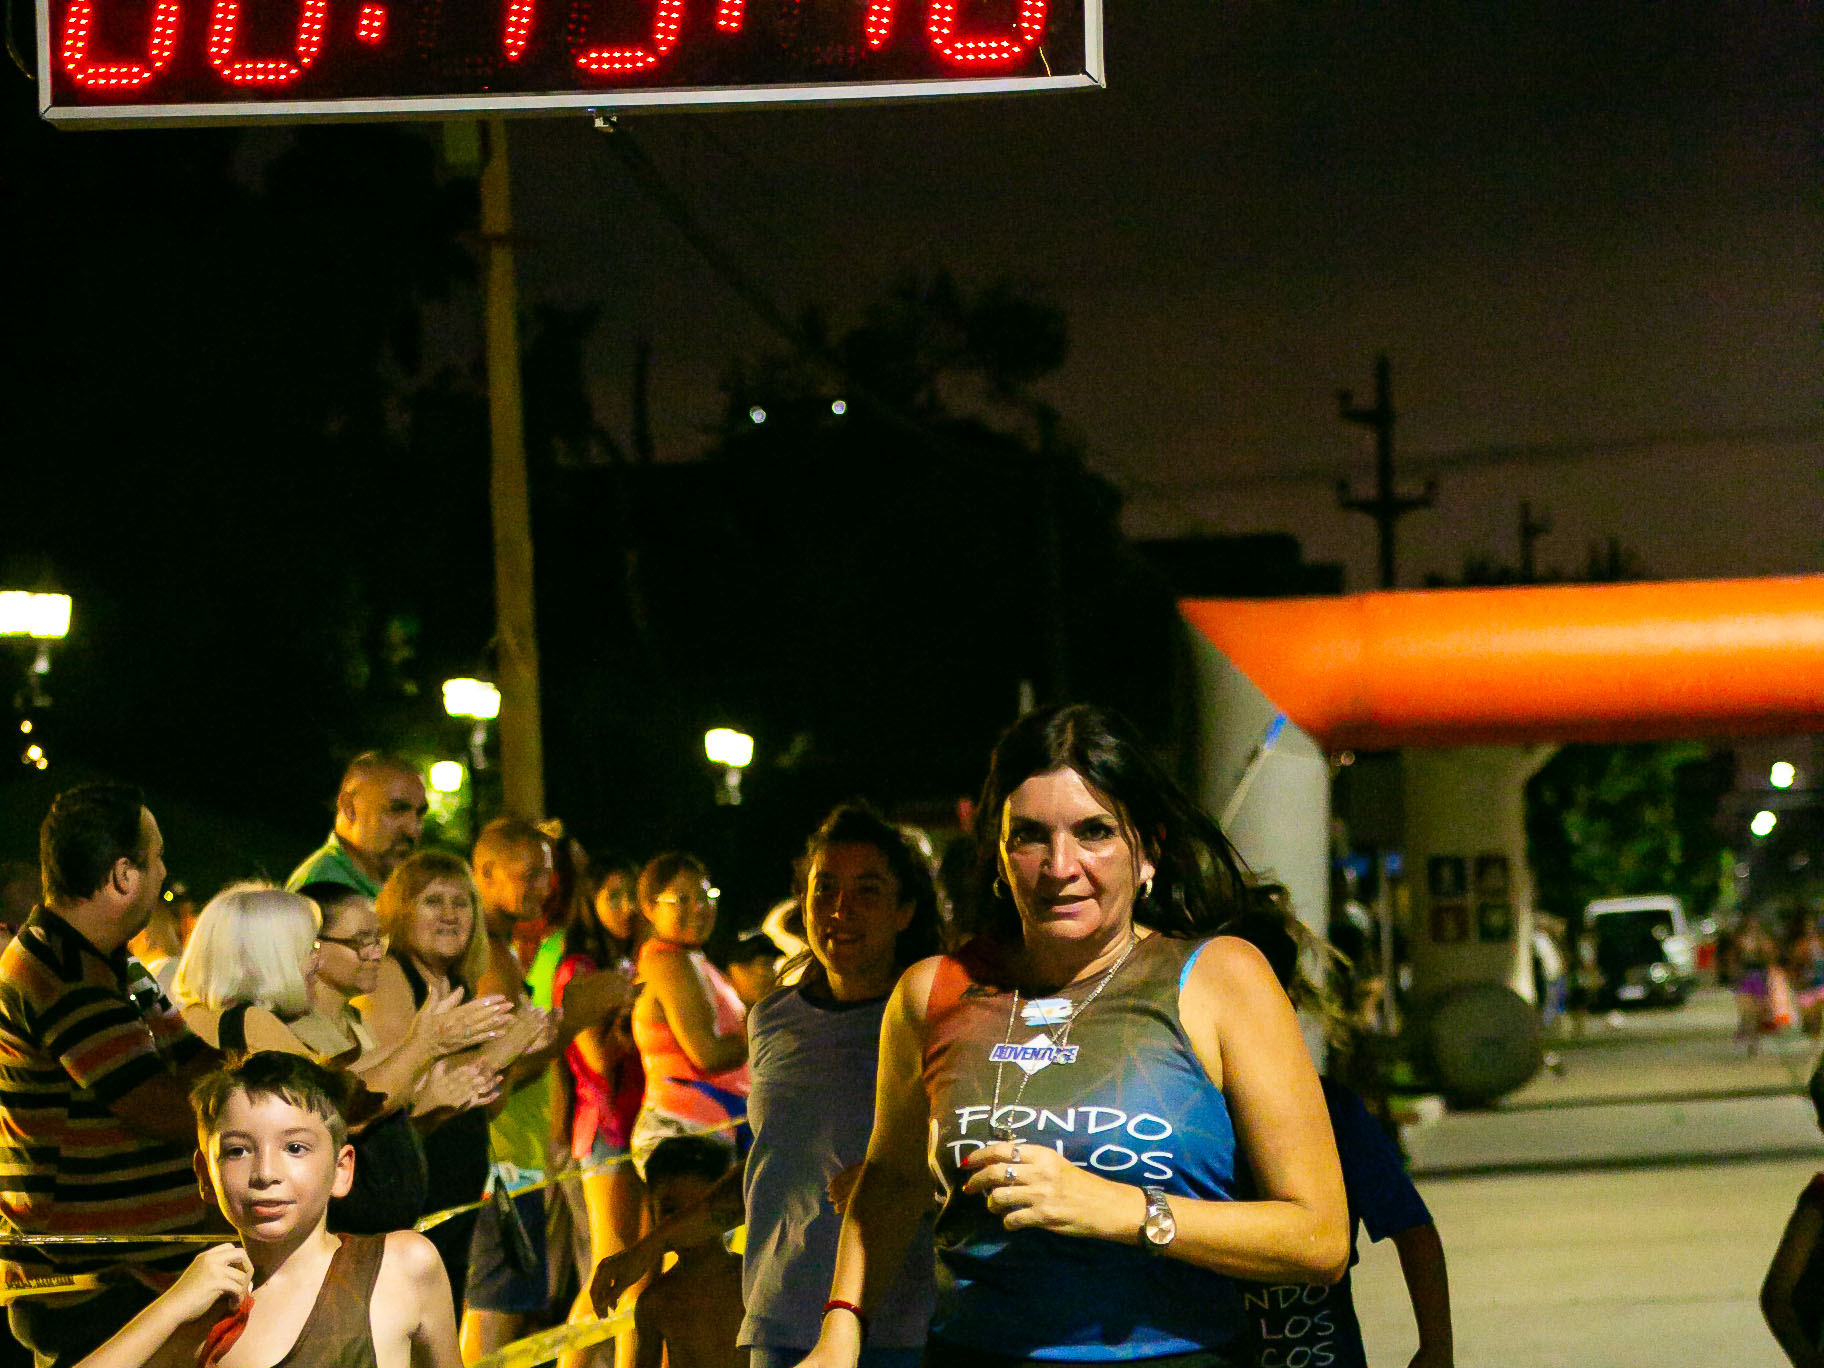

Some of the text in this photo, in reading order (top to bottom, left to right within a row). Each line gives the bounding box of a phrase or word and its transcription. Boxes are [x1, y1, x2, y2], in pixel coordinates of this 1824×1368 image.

[991, 1044, 1077, 1061] ADVENTUE
[954, 1104, 1173, 1141] FONDO
[946, 1138, 1173, 1180] D LOS
[1244, 1284, 1329, 1310] NDO
[1260, 1309, 1335, 1339] LOS
[1261, 1341, 1335, 1368] COS
